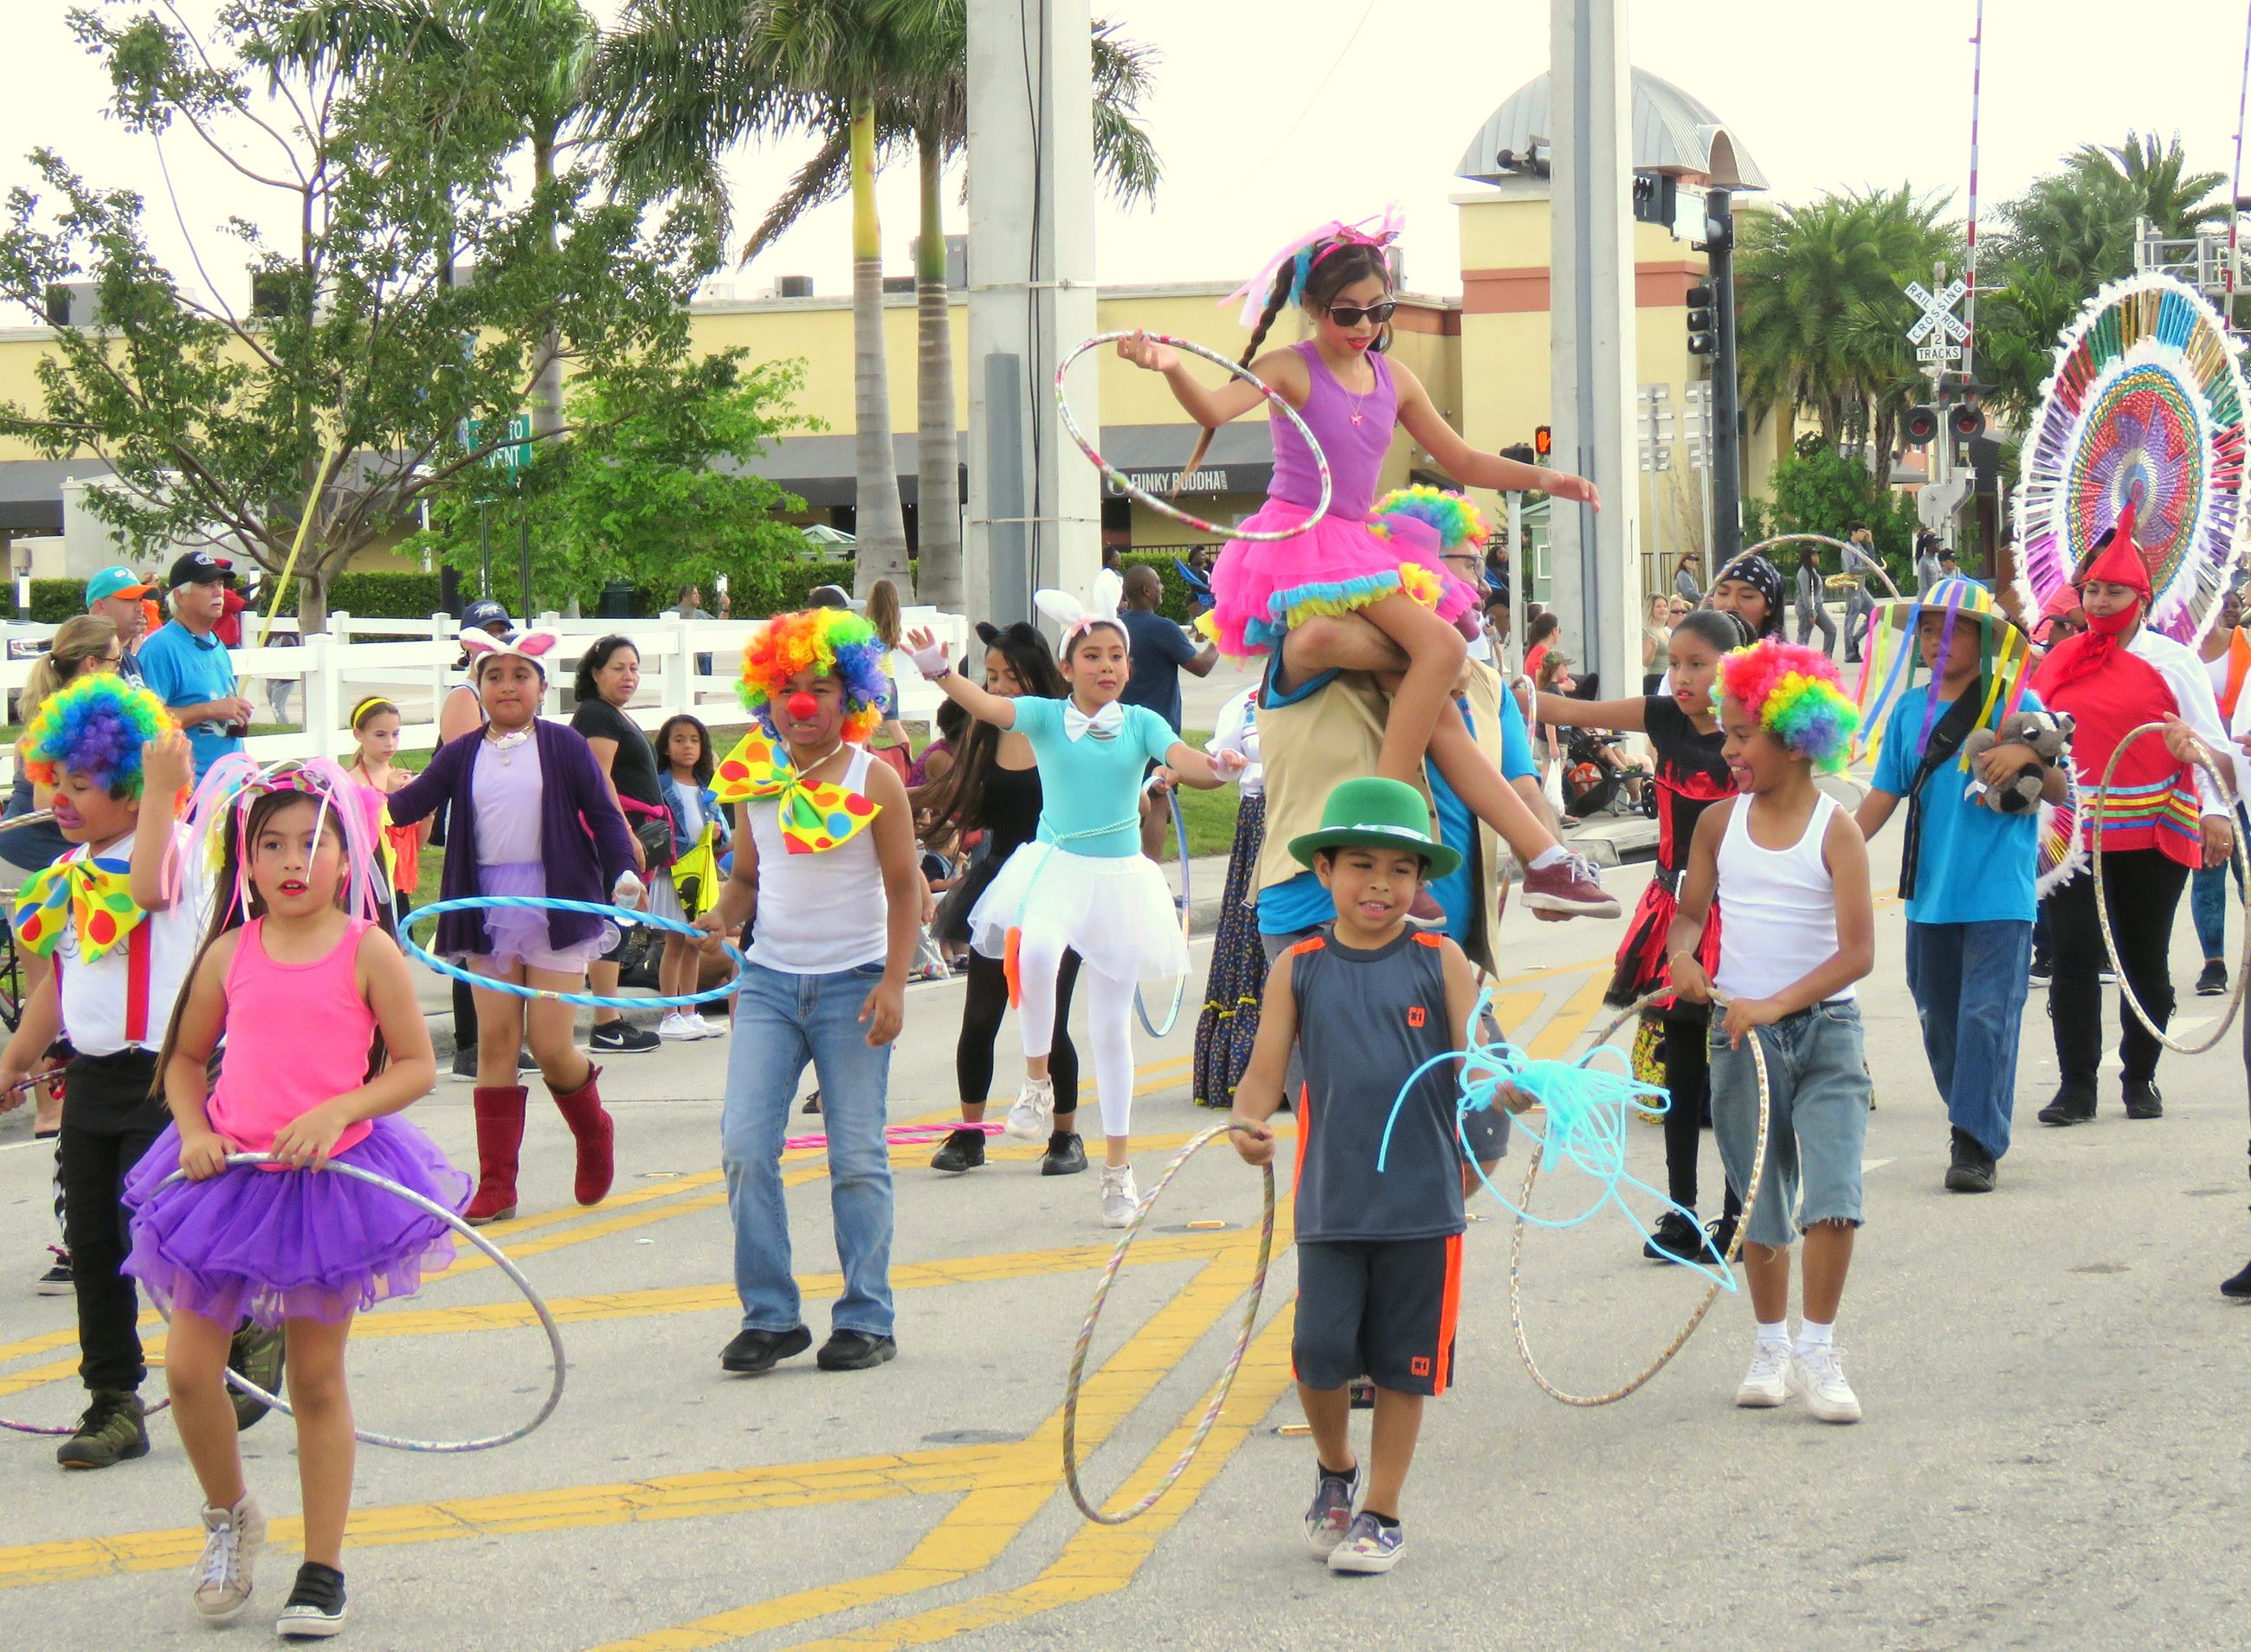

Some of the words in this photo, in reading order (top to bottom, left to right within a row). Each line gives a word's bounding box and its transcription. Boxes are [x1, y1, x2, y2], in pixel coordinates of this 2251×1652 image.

[1907, 284, 1932, 307] RAIL
[1941, 314, 1966, 343] ROAD
[1912, 284, 1963, 339] CROSSING
[1934, 333, 1942, 345] 2
[1919, 348, 1959, 360] TRACKS
[1131, 473, 1169, 493] FUNKY
